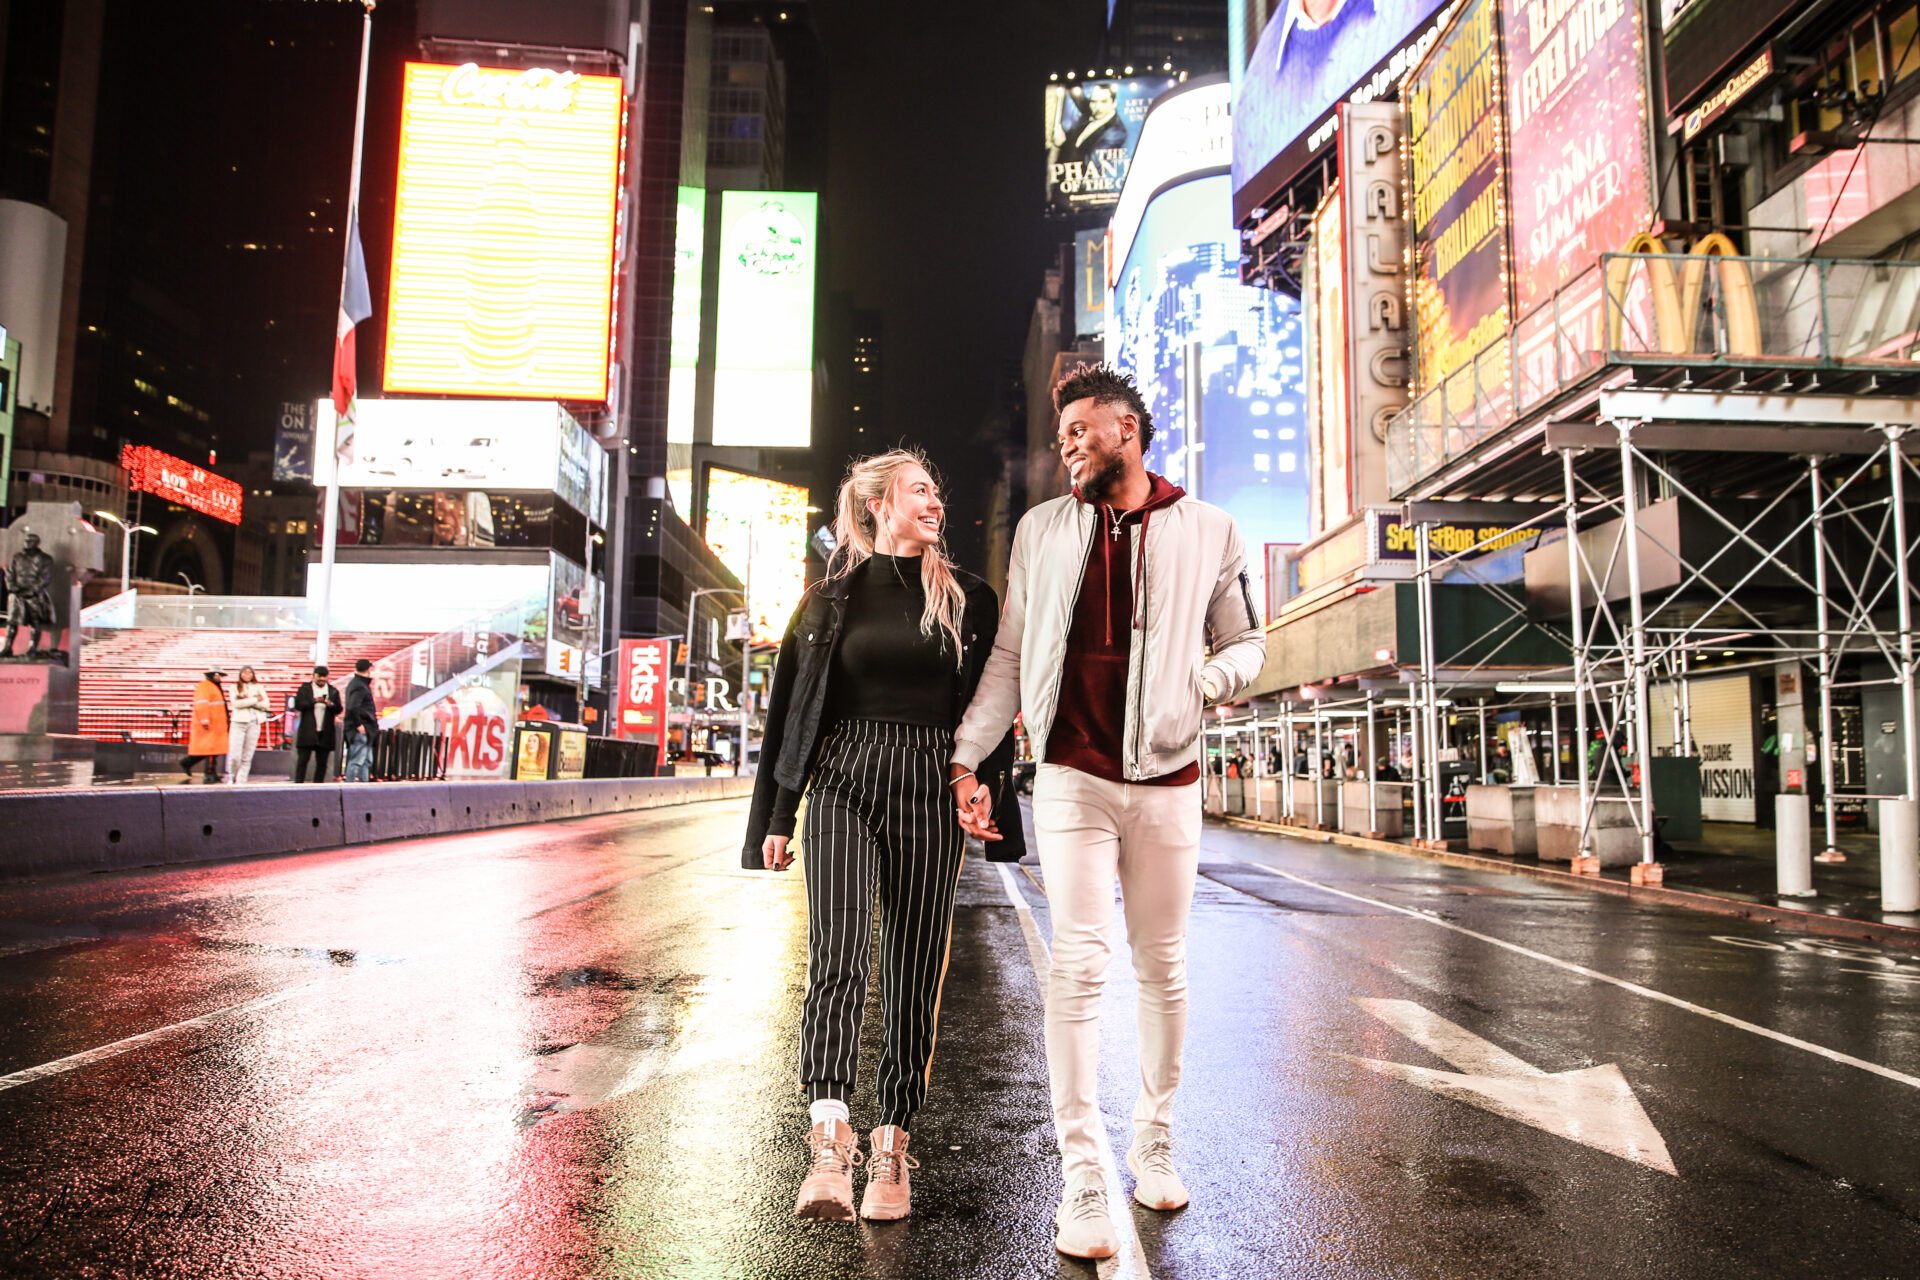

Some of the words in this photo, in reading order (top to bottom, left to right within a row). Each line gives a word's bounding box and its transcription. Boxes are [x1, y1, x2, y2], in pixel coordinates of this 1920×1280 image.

[1522, 27, 1568, 122] FEVER
[1411, 48, 1494, 194] BROADWAY
[1095, 148, 1129, 160] THE
[1535, 129, 1607, 222] DONNA
[1060, 180, 1081, 193] OF
[1083, 178, 1112, 191] THE
[1530, 161, 1621, 265] SUMMER
[283, 403, 306, 416] THE
[1386, 523, 1475, 552] SPOGEBOB
[630, 645, 661, 706] tkts
[705, 677, 739, 712] R
[434, 695, 506, 772] tkts
[1702, 744, 1732, 761] SQUARE
